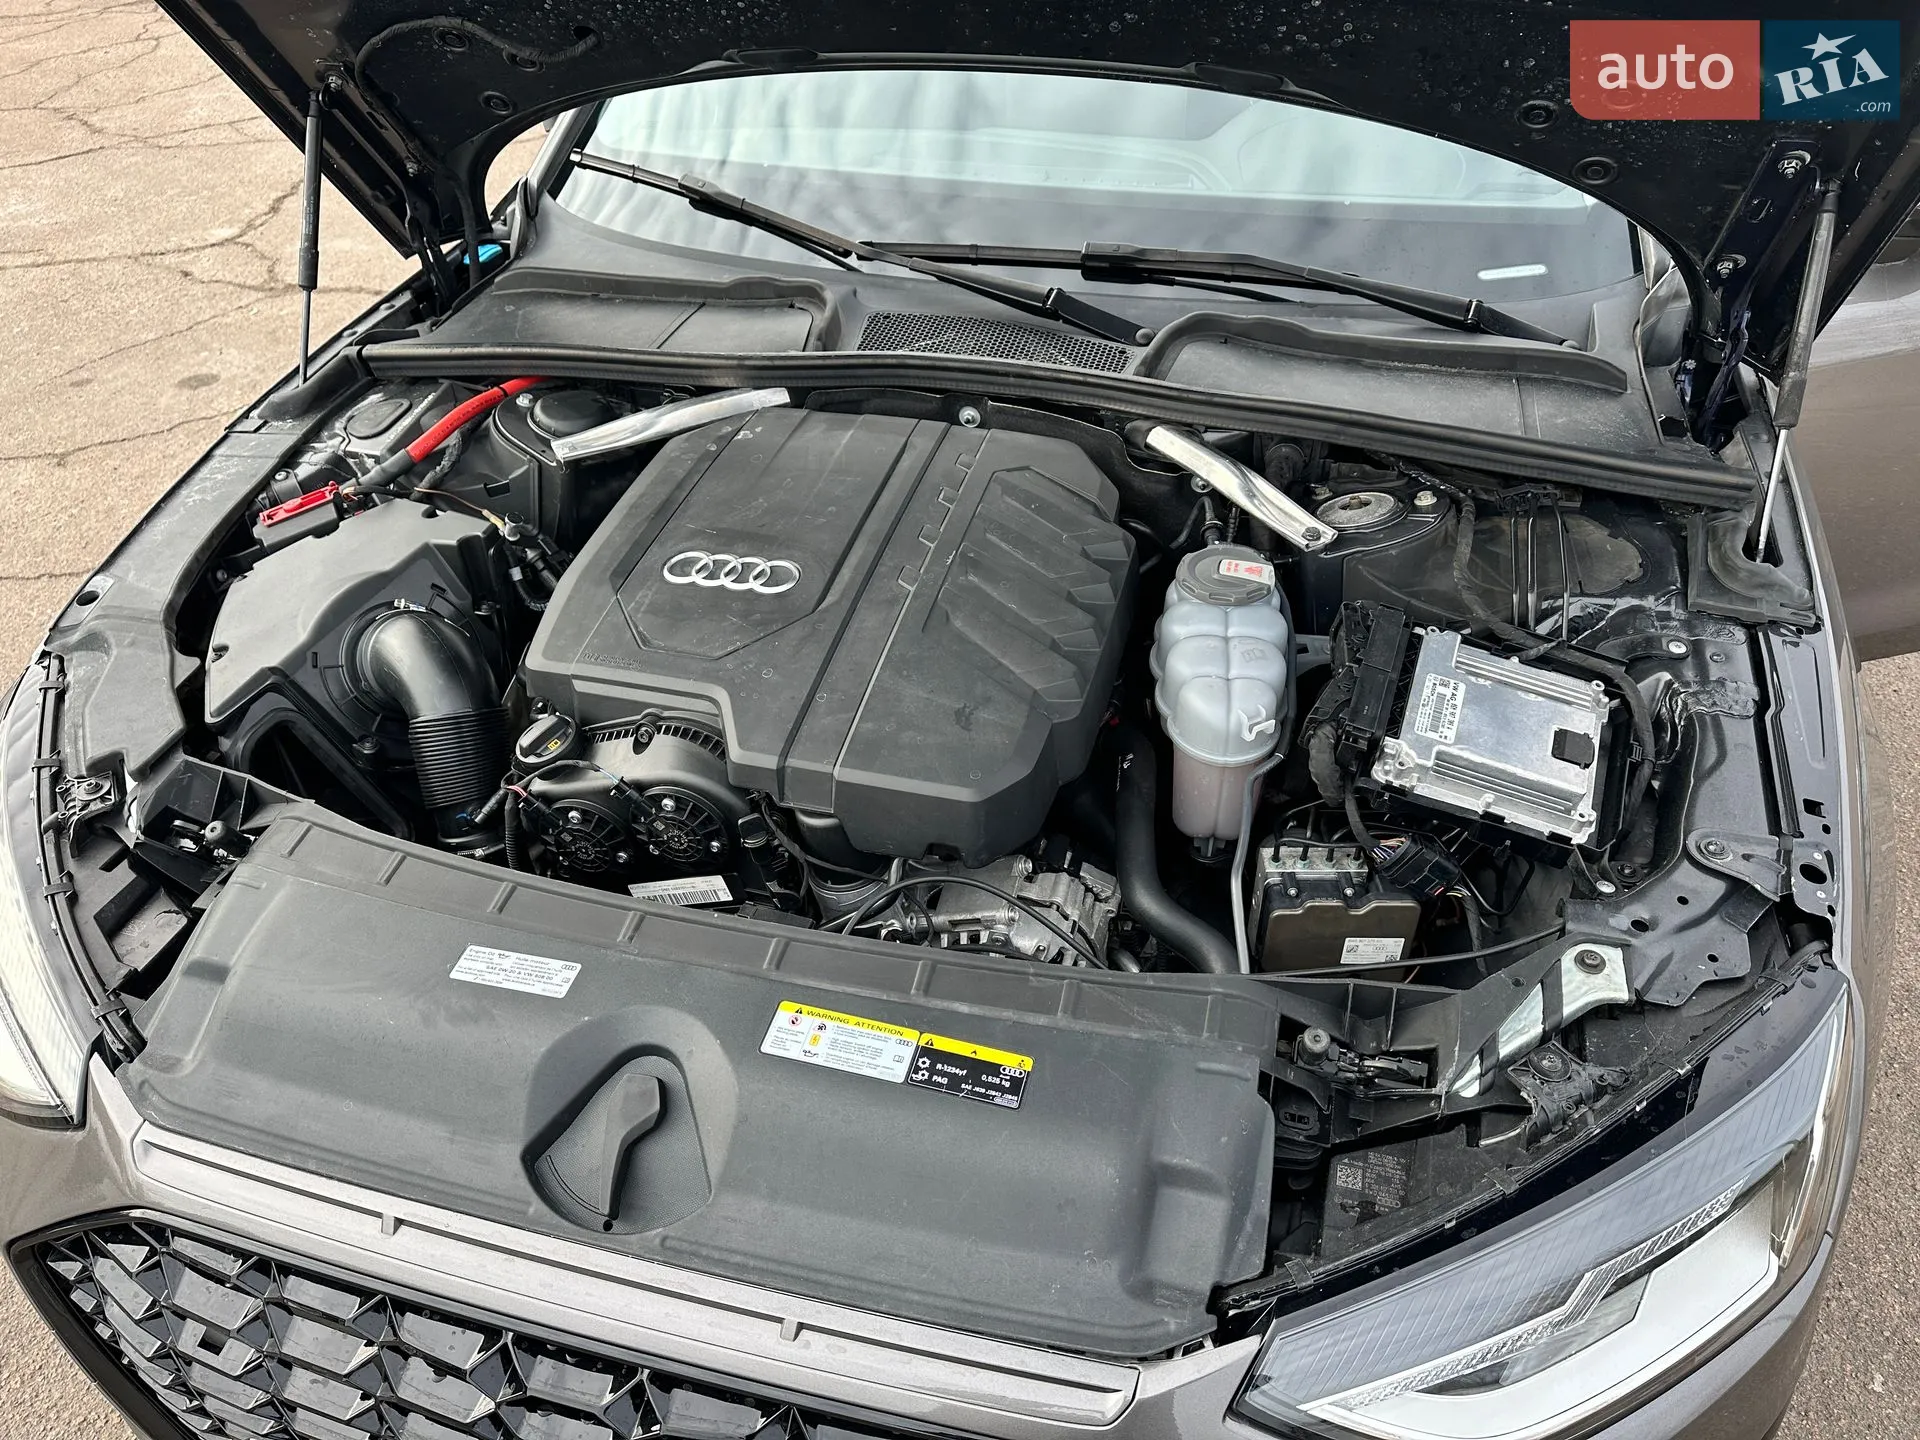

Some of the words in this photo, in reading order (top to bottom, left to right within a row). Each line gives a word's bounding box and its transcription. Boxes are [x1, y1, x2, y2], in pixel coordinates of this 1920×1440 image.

[1450, 692, 1457, 701] AG
[806, 1009, 850, 1025] WARNING
[854, 1020, 904, 1037] ATTENTION
[935, 1063, 967, 1076] R-1234yf
[932, 1075, 948, 1084] PAG
[1001, 1079, 1011, 1088] kg
